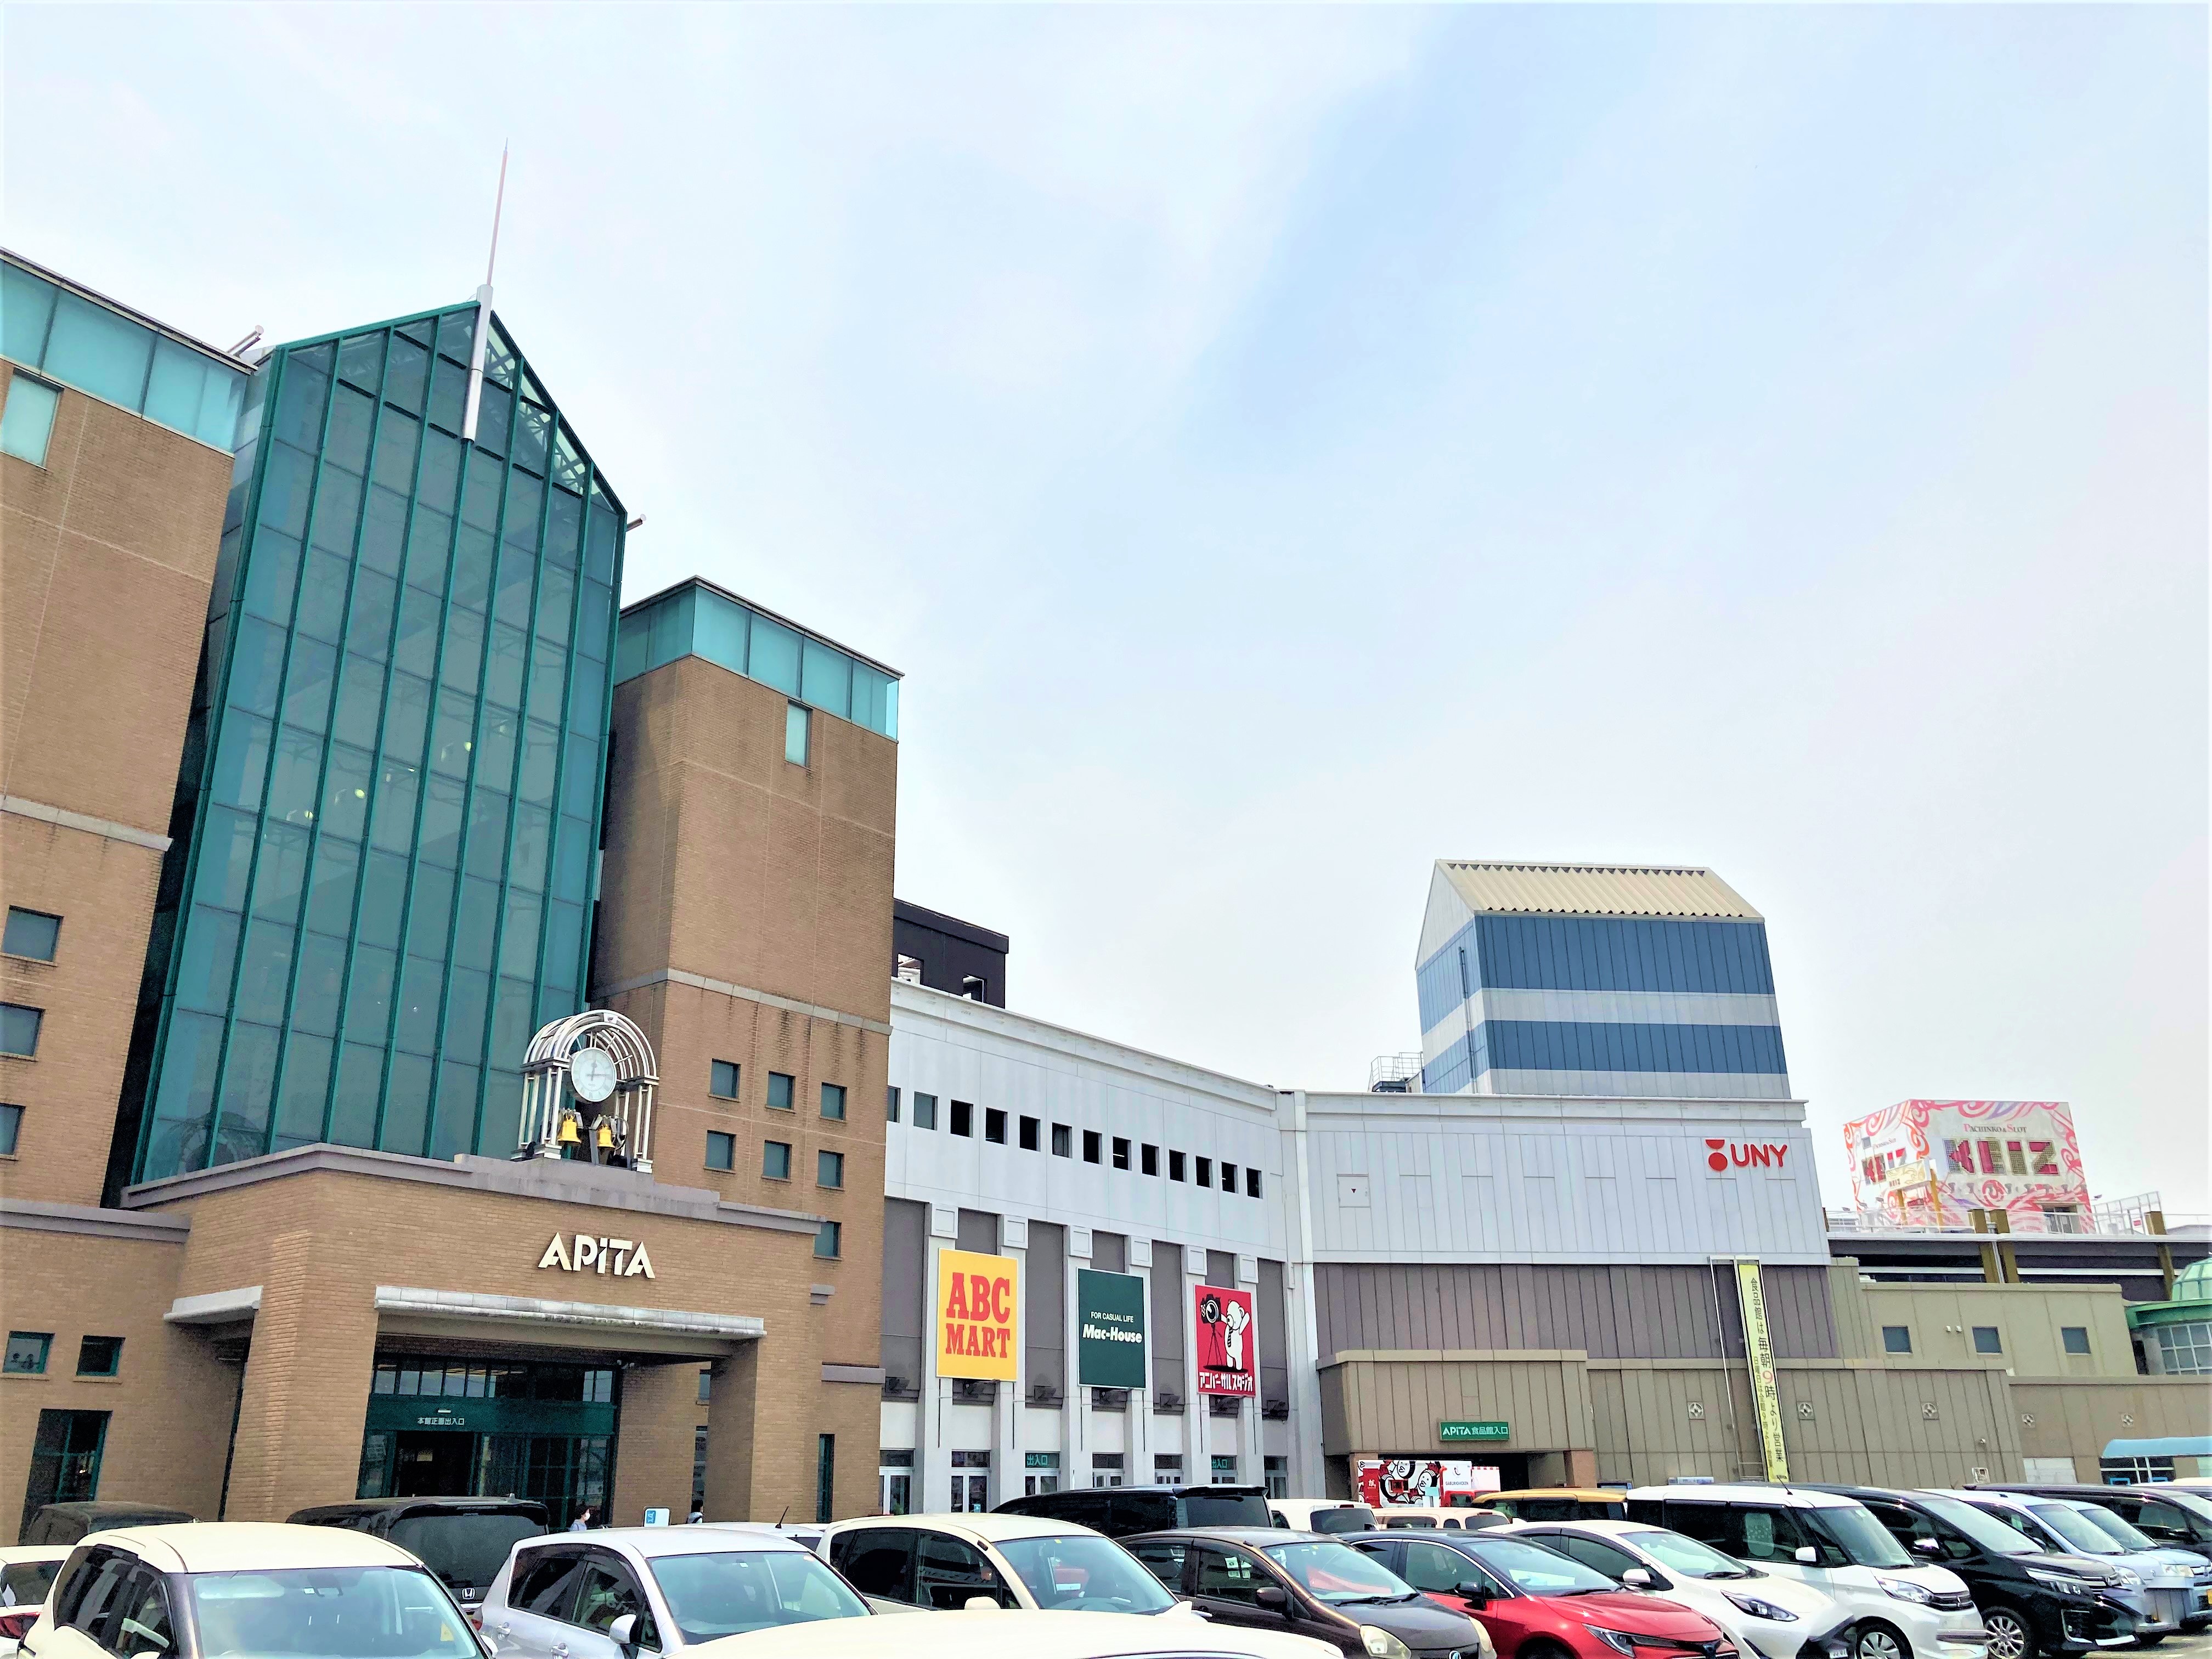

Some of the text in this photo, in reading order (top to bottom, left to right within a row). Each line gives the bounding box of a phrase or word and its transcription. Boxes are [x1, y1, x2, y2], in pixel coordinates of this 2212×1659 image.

[1730, 1143, 1788, 1167] UNY
[1942, 1137, 2061, 1176] KEIZ
[946, 1272, 1010, 1323] ABC
[1091, 1311, 1102, 1319] FOR
[1102, 1312, 1122, 1322] CASUAL
[946, 1323, 1010, 1358] MART
[1082, 1323, 1143, 1343] Mac-House
[1026, 1454, 1048, 1466] 出入口
